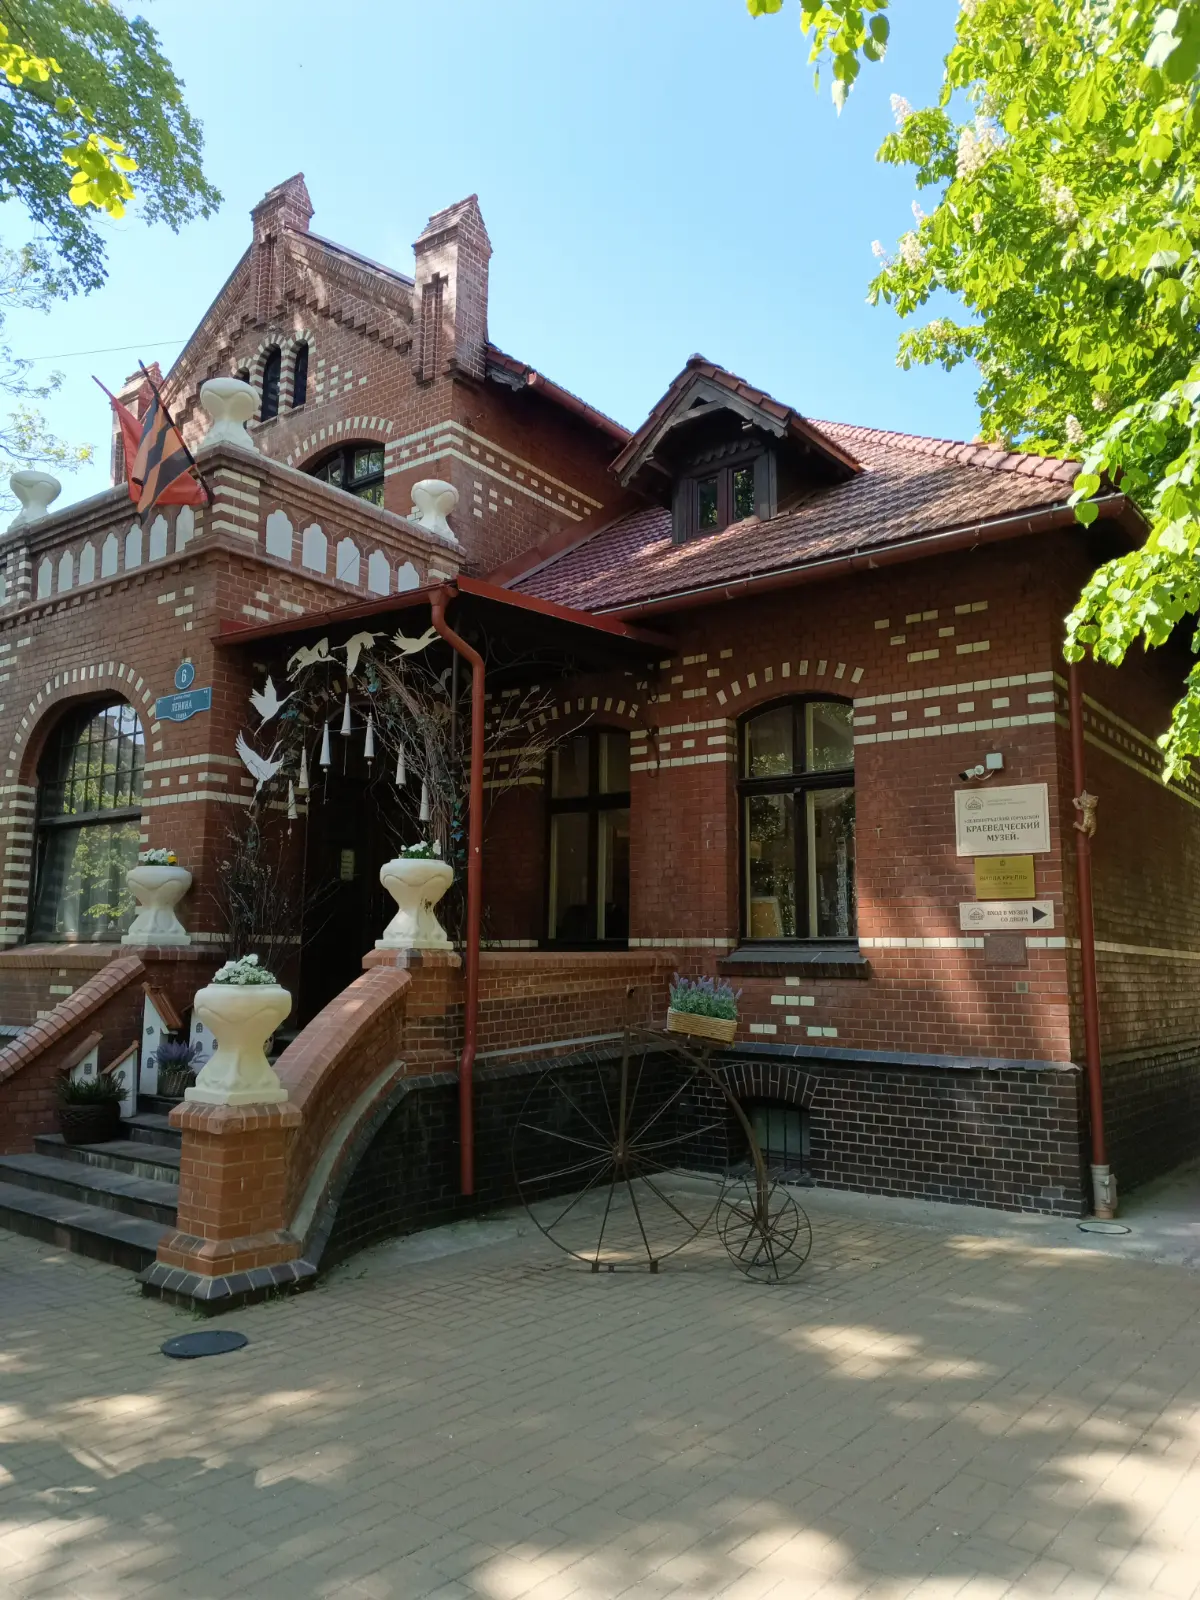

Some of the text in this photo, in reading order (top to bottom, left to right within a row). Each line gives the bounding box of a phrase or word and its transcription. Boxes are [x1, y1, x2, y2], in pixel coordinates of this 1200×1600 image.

[182, 669, 186, 682] 6
[171, 700, 192, 712] ЛЕНИНА
[966, 820, 1040, 832] КРАЕВЕДЧЕСКИЙ
